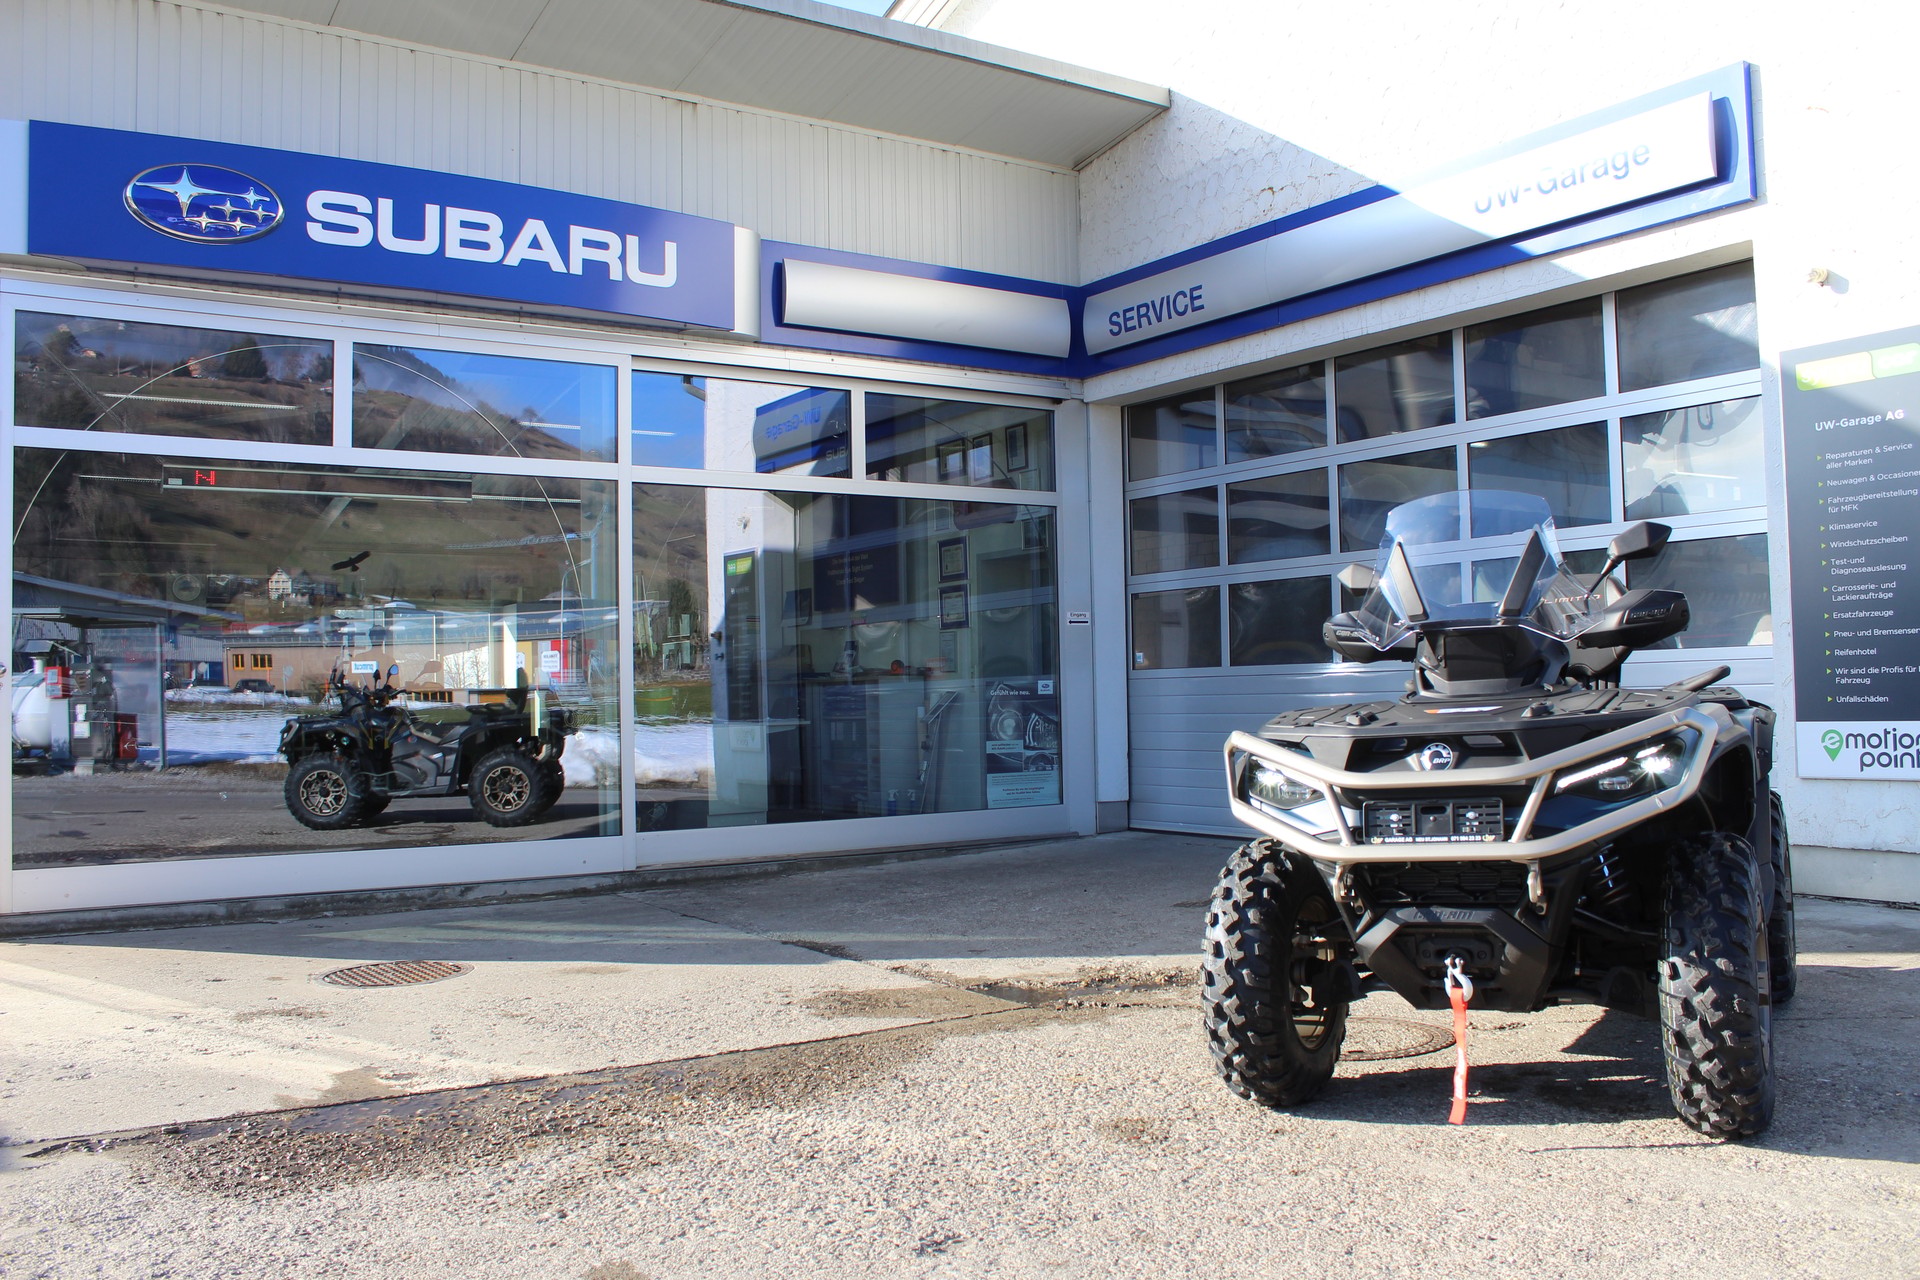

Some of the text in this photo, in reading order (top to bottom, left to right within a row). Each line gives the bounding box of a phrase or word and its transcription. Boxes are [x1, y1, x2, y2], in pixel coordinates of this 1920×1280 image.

[1475, 144, 1650, 214] UW-Garage
[305, 189, 678, 288] SUBARU
[1108, 284, 1205, 337] SERVICE
[1815, 409, 1904, 431] UW-Garage AG
[825, 446, 849, 461] SUB
[1825, 443, 1913, 460] Reparaturen & Service
[1844, 457, 1873, 467] Marken
[1827, 475, 1868, 487] Neuwagen
[1827, 488, 1918, 504] Fahrzeugbereitstellung
[1841, 504, 1859, 512] MFK
[1829, 520, 1878, 531] Klimaservice
[1829, 535, 1908, 548] Windschutzscheiben
[1831, 563, 1907, 575] Diagnoseauslesung
[1831, 583, 1878, 592] Carrosserie-
[1832, 592, 1893, 602] Lackieraufträge
[1833, 609, 1894, 619] Ersatzfahrzeuge
[1833, 630, 1855, 638] Pneu-
[1857, 629, 1872, 637] und
[1834, 648, 1877, 656] Reifenhotel
[1835, 667, 1848, 675] Wir
[1850, 667, 1866, 675] sind
[1867, 666, 1879, 674] die
[1881, 666, 1904, 674] Profis
[1905, 665, 1917, 673] für
[1835, 677, 1871, 685] Fahrzeug
[1836, 695, 1889, 703] Unfallschäden
